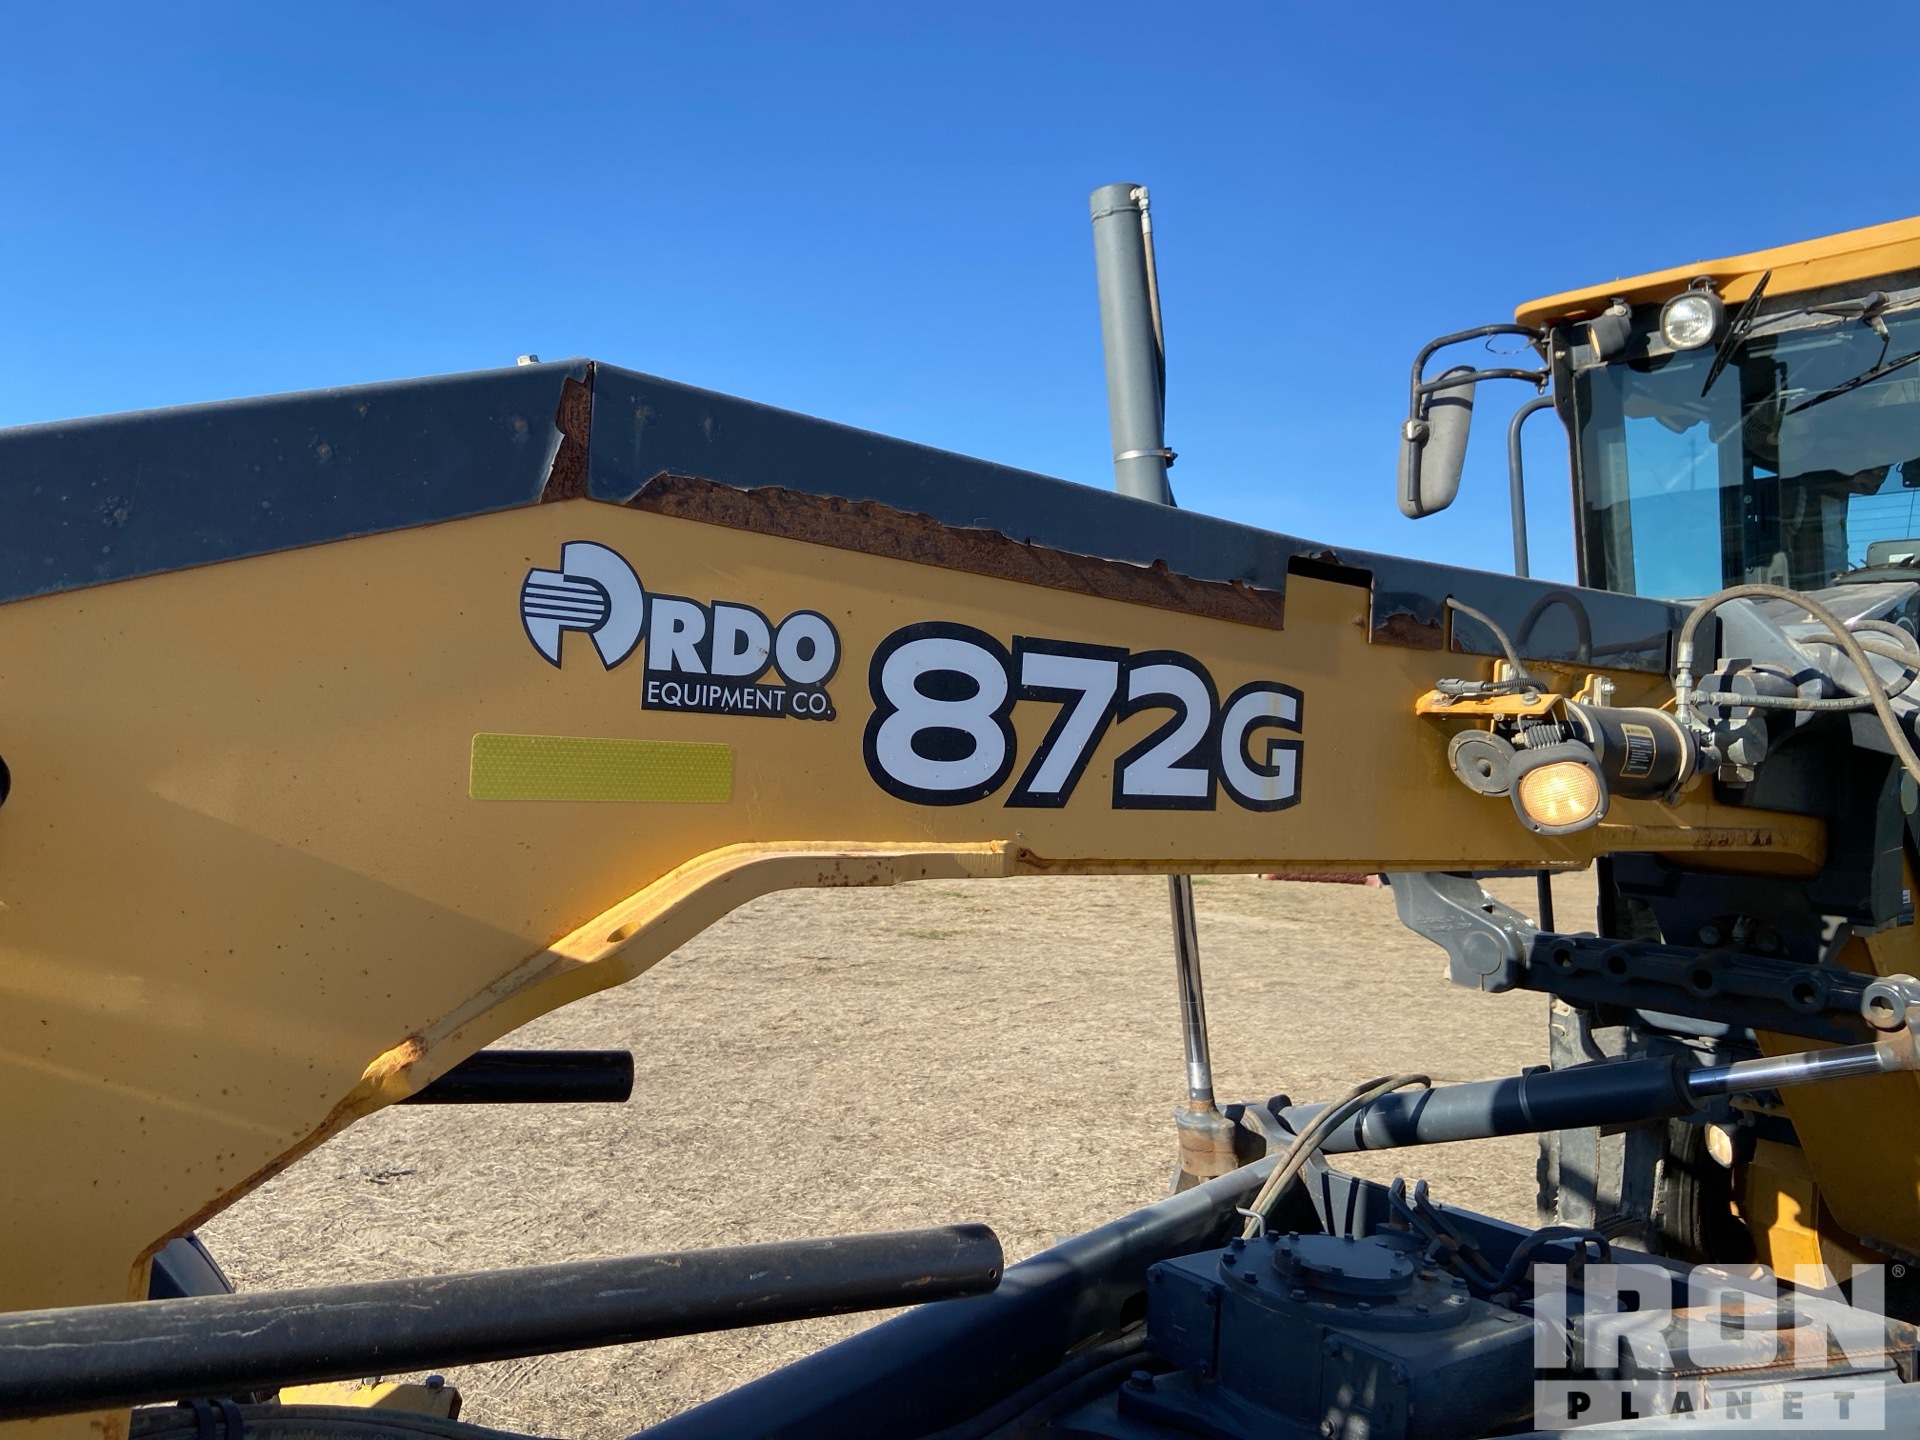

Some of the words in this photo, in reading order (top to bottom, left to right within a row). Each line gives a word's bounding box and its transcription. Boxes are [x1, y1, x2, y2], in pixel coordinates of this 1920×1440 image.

[647, 596, 838, 686] RDO
[647, 680, 787, 712] EQUIPMENT
[792, 692, 832, 714] CO.
[864, 622, 1304, 811] 872G
